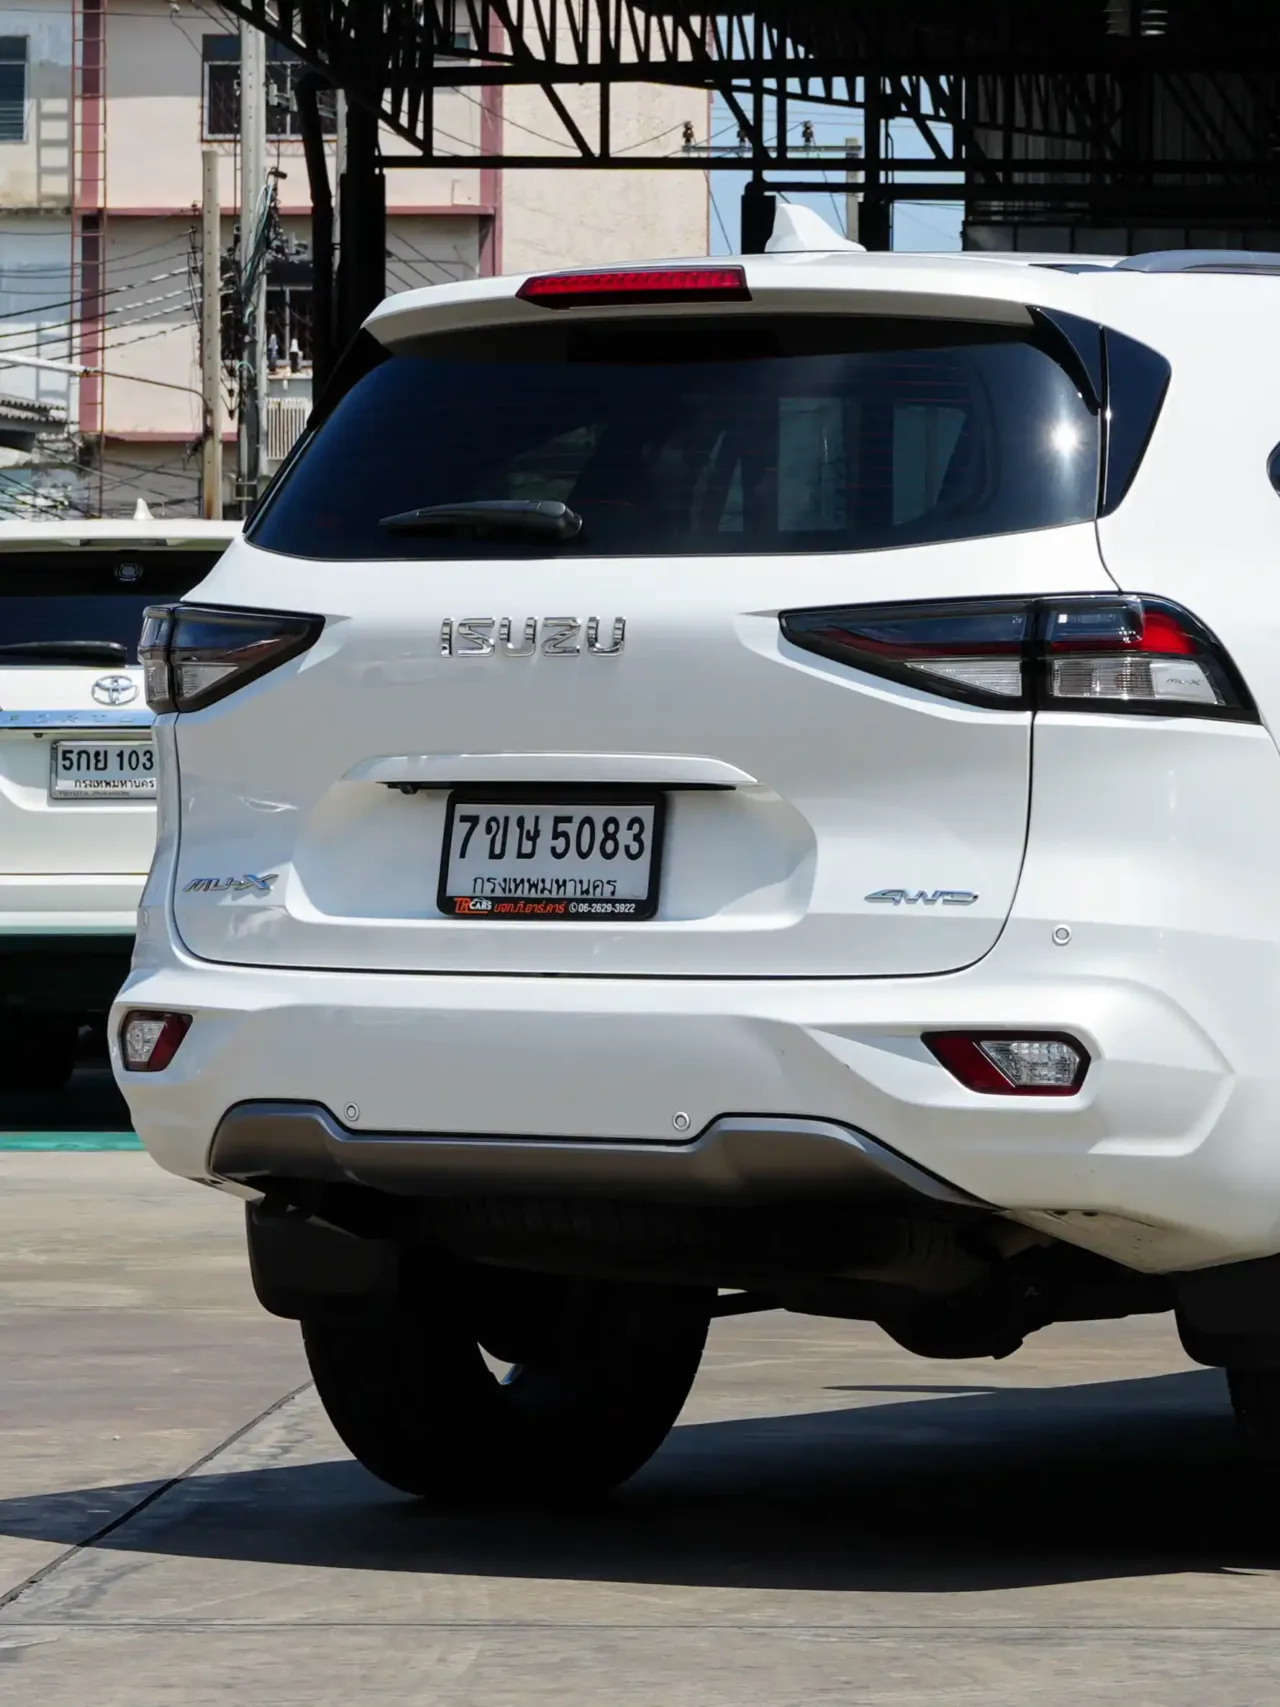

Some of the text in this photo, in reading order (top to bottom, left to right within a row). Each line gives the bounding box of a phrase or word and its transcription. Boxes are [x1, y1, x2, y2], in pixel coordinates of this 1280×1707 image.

[440, 616, 627, 658] ISUZU
[62, 749, 154, 772] 5กย 103
[458, 814, 646, 861] 7ขษ 5083
[578, 903, 636, 914] 06-2629-3922
[863, 888, 979, 906] 4WD
